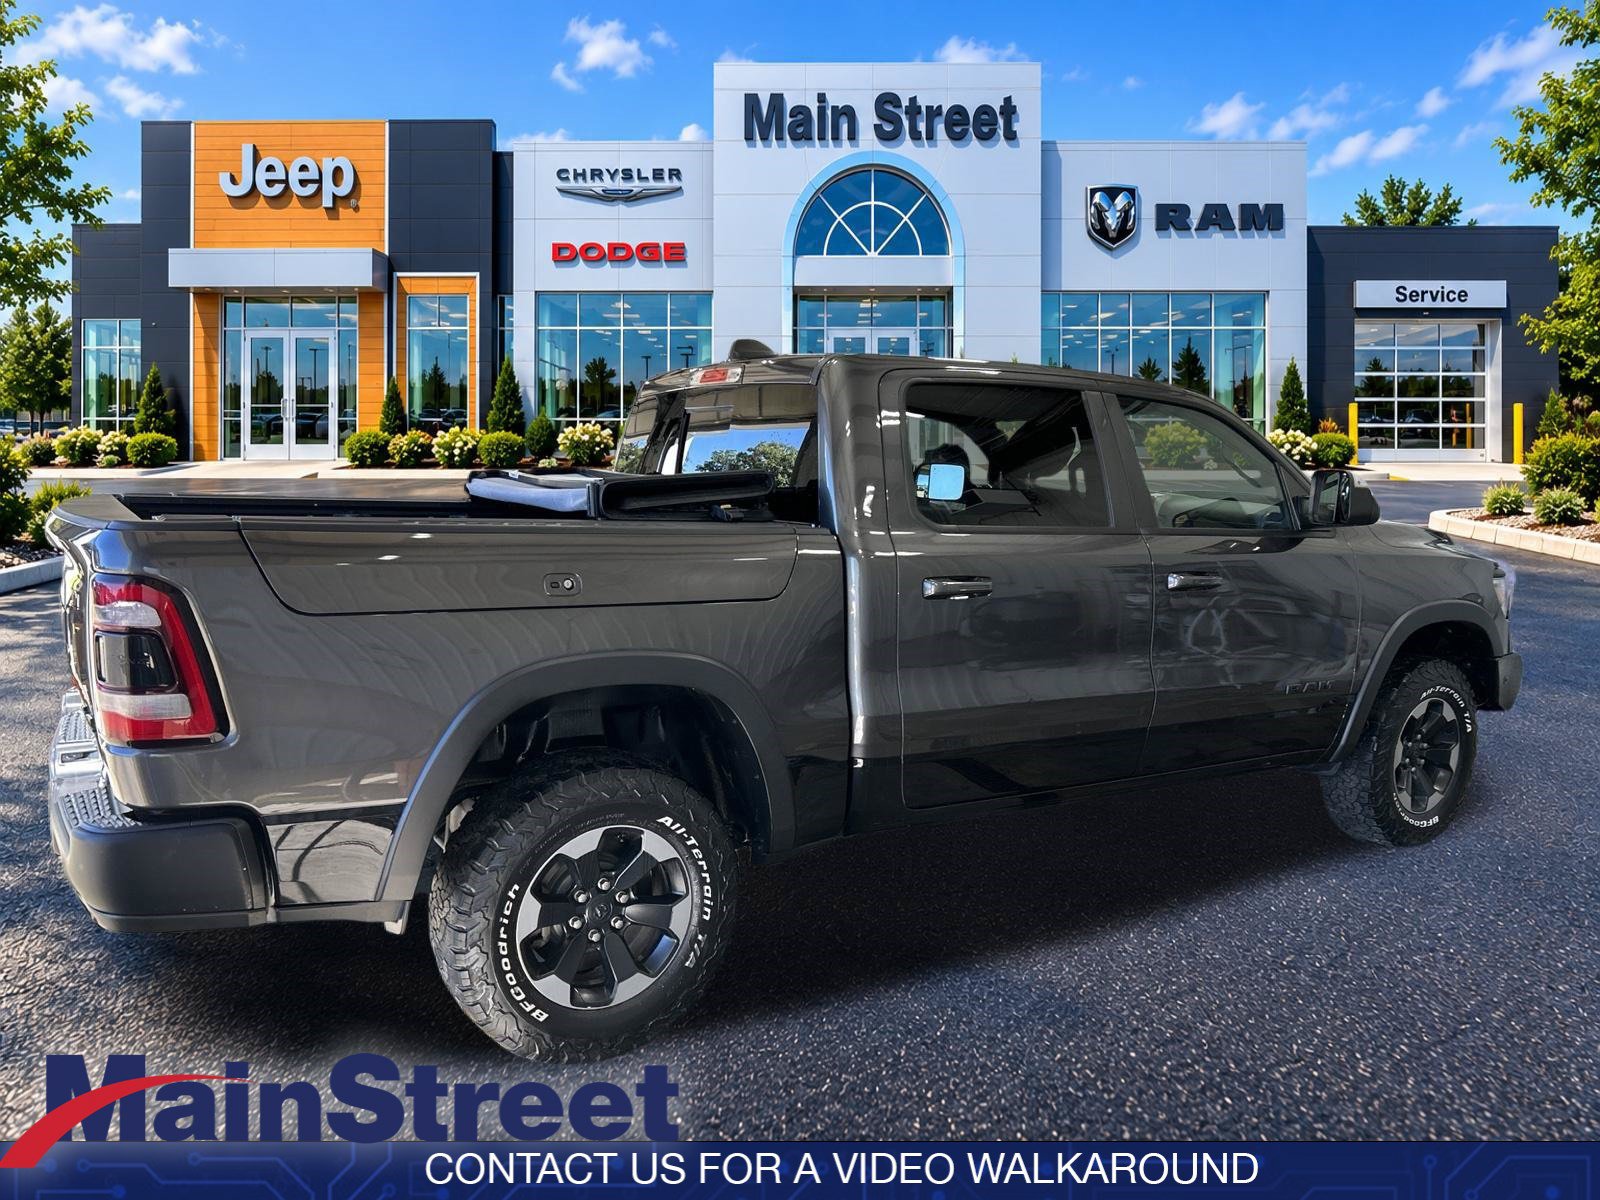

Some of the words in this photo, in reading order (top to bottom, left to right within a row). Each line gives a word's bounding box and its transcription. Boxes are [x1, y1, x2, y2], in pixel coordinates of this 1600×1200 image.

[744, 92, 857, 142] Main
[874, 92, 1018, 142] Street
[219, 143, 355, 210] Jeep
[556, 168, 682, 182] CHRYSLER
[1155, 203, 1284, 232] RAM
[551, 242, 686, 262] DODGE
[1395, 285, 1469, 303] Service
[1420, 685, 1465, 708] All-Terrain
[1463, 711, 1473, 733] T/A
[656, 816, 715, 921] All-Terrain
[498, 883, 549, 1022] BFGoodrich
